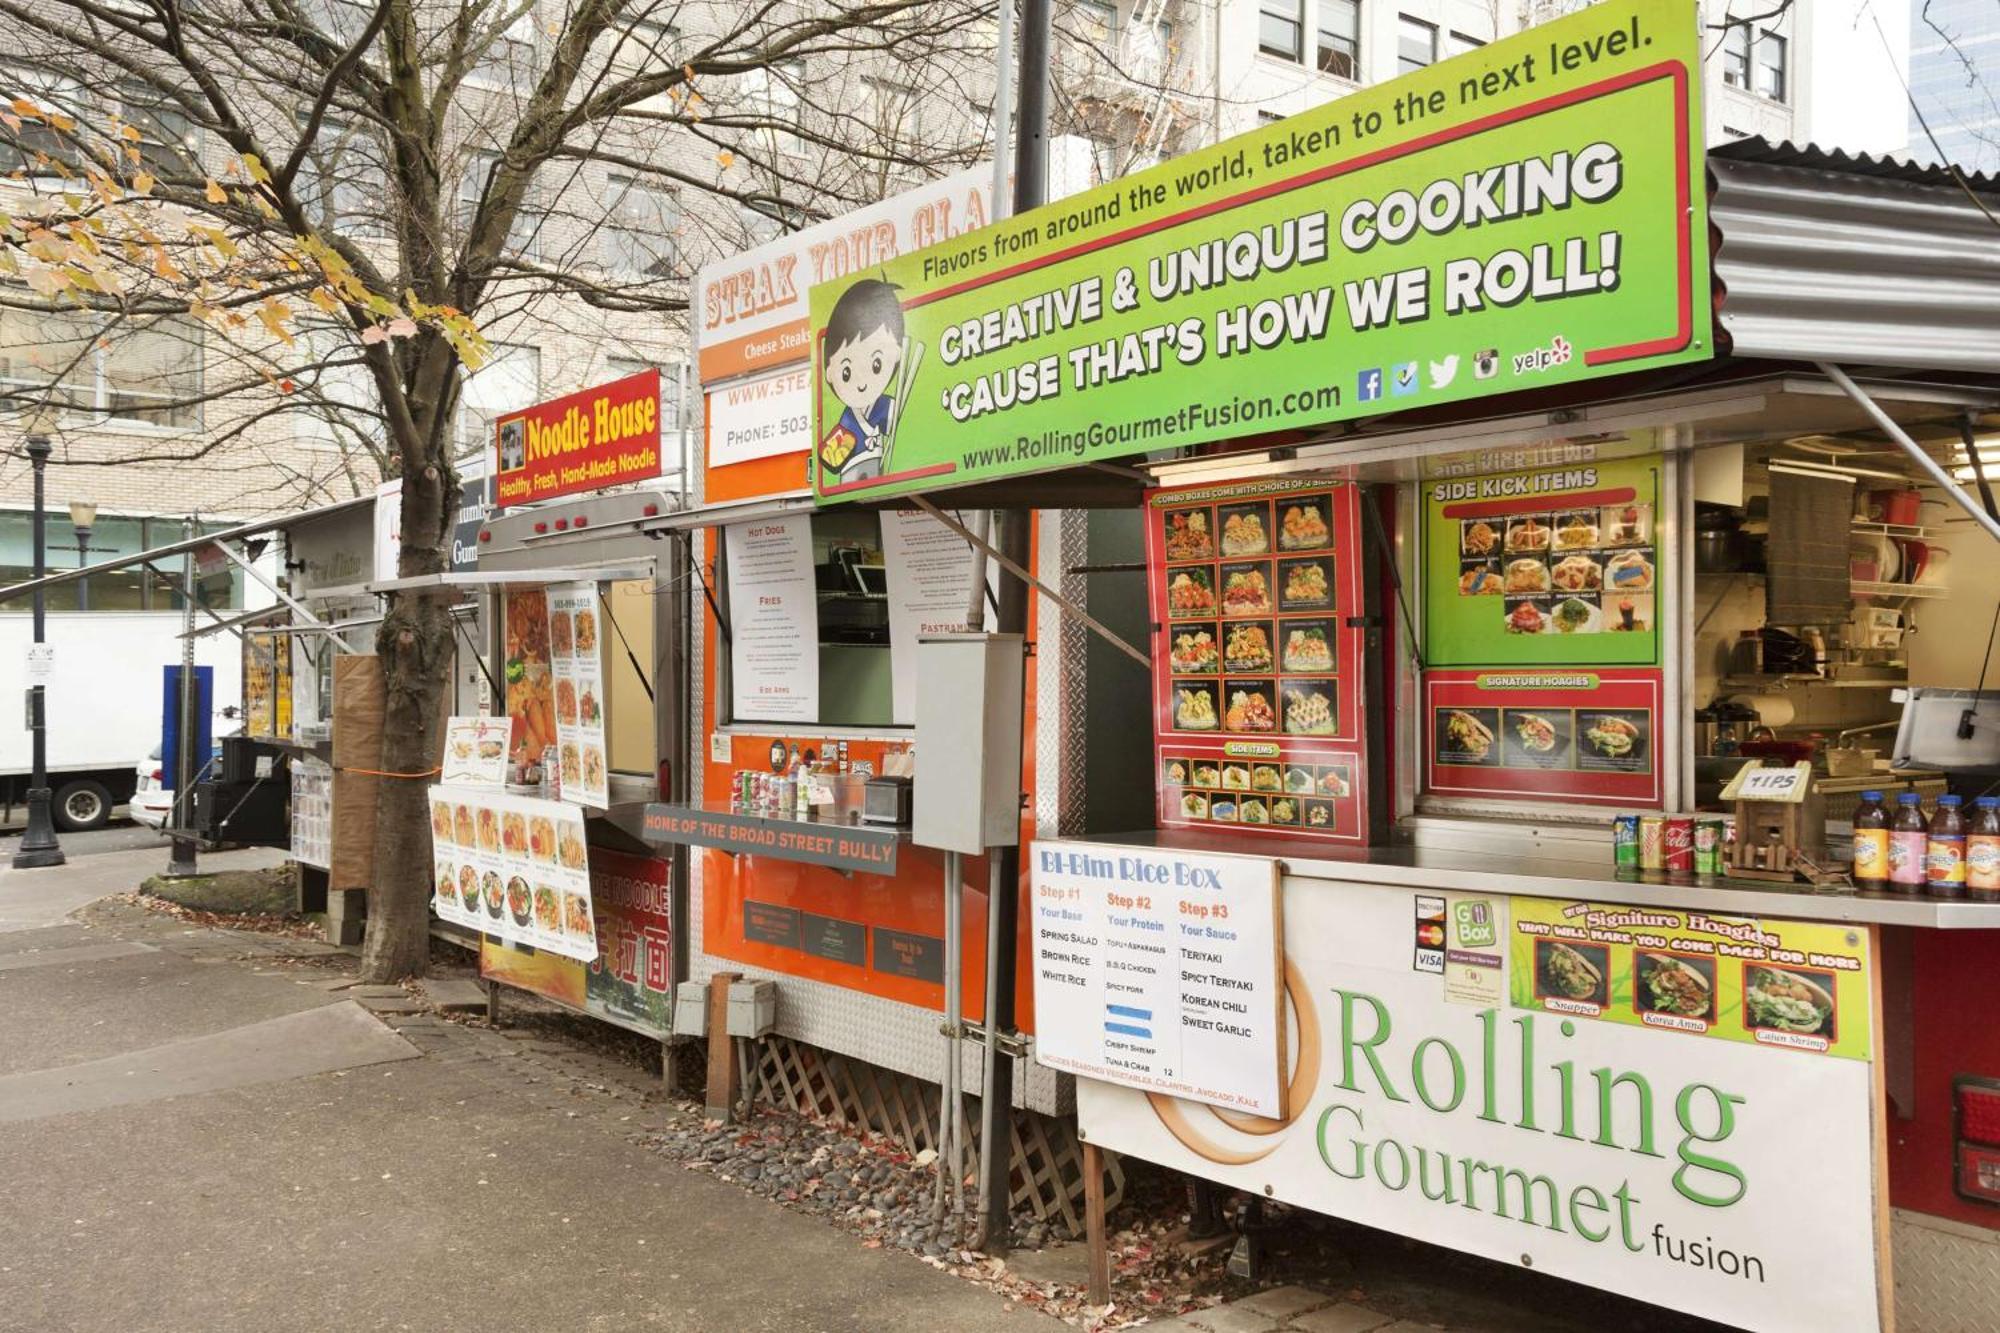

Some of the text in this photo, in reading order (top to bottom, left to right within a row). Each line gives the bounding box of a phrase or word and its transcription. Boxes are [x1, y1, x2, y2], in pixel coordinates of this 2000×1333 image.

[923, 15, 1653, 281] Flavors from around the world, taken to the next level.
[938, 141, 1624, 366] CREATIVE & UNIQUE COOKING
[705, 252, 798, 330] STEAK
[808, 219, 900, 287] YOUR
[941, 231, 1622, 424] 'CAUSE THAT'S HOW WE ROLL!
[744, 341, 777, 361] Cheese
[1513, 349, 1553, 376] yelp
[728, 372, 812, 406] WWW.STE
[527, 395, 656, 462] Noodle House
[727, 424, 775, 448] PHONE:
[961, 383, 1342, 471] www.RollingGourmetFusion.com
[499, 447, 656, 498] Healthy, Fresh, Hand-Made Noodle
[1157, 494, 1184, 504] COMBO
[1186, 491, 1211, 502] BOXES
[1211, 488, 1236, 499] COME
[1236, 485, 1257, 497] WITH
[1258, 481, 1290, 492] CHOICE
[1434, 468, 1598, 502] SIDE KICK ITEMS
[759, 595, 781, 606] FRIES
[1486, 676, 1590, 688] SIGNATURE HOAGIES
[1231, 744, 1275, 755] SIDE ITEMS
[1752, 774, 1797, 789] TIPS
[646, 815, 892, 863] HOME OF THE BROAD STREET BULLY
[1119, 858, 1169, 885] Rice
[612, 875, 669, 916] NOODLE
[1041, 885, 1081, 901] Step #1
[1107, 893, 1152, 910] Step #2
[1041, 907, 1083, 921] Your Base
[1179, 900, 1229, 919] Step #3
[1107, 915, 1165, 932] Your Protein
[1180, 923, 1238, 941] Your Sauce
[1587, 909, 1780, 948] Signiture Hoagies
[1041, 929, 1098, 945] SPRING SALAD
[1518, 921, 1861, 970] THAT WILL MAKE YOU COME BACK FOR MORE
[1041, 949, 1091, 966] BROWN RICE
[1181, 949, 1222, 964] TERIYAKI
[1419, 954, 1442, 967] VISA
[1042, 970, 1086, 987] WHITE RICE
[1127, 962, 1156, 974] CHICKEN
[1106, 982, 1125, 992] SPICY
[1181, 970, 1253, 991] SPICY TERIYAKI
[1182, 993, 1220, 1009] KOREAN
[1222, 1000, 1247, 1014] CHILI
[1182, 1015, 1252, 1039] SWEET GARLIC
[1645, 1014, 1704, 1031] Korea Anna
[1105, 1040, 1156, 1055] CRISPY SHRIMP
[1757, 1031, 1826, 1051] Cajun Shrimp
[1105, 1057, 1173, 1077] TUNA & CRAB 12
[1331, 987, 1748, 1208] Rolling
[1317, 1103, 1646, 1253] Gourmet
[1653, 1222, 1765, 1284] fusion
